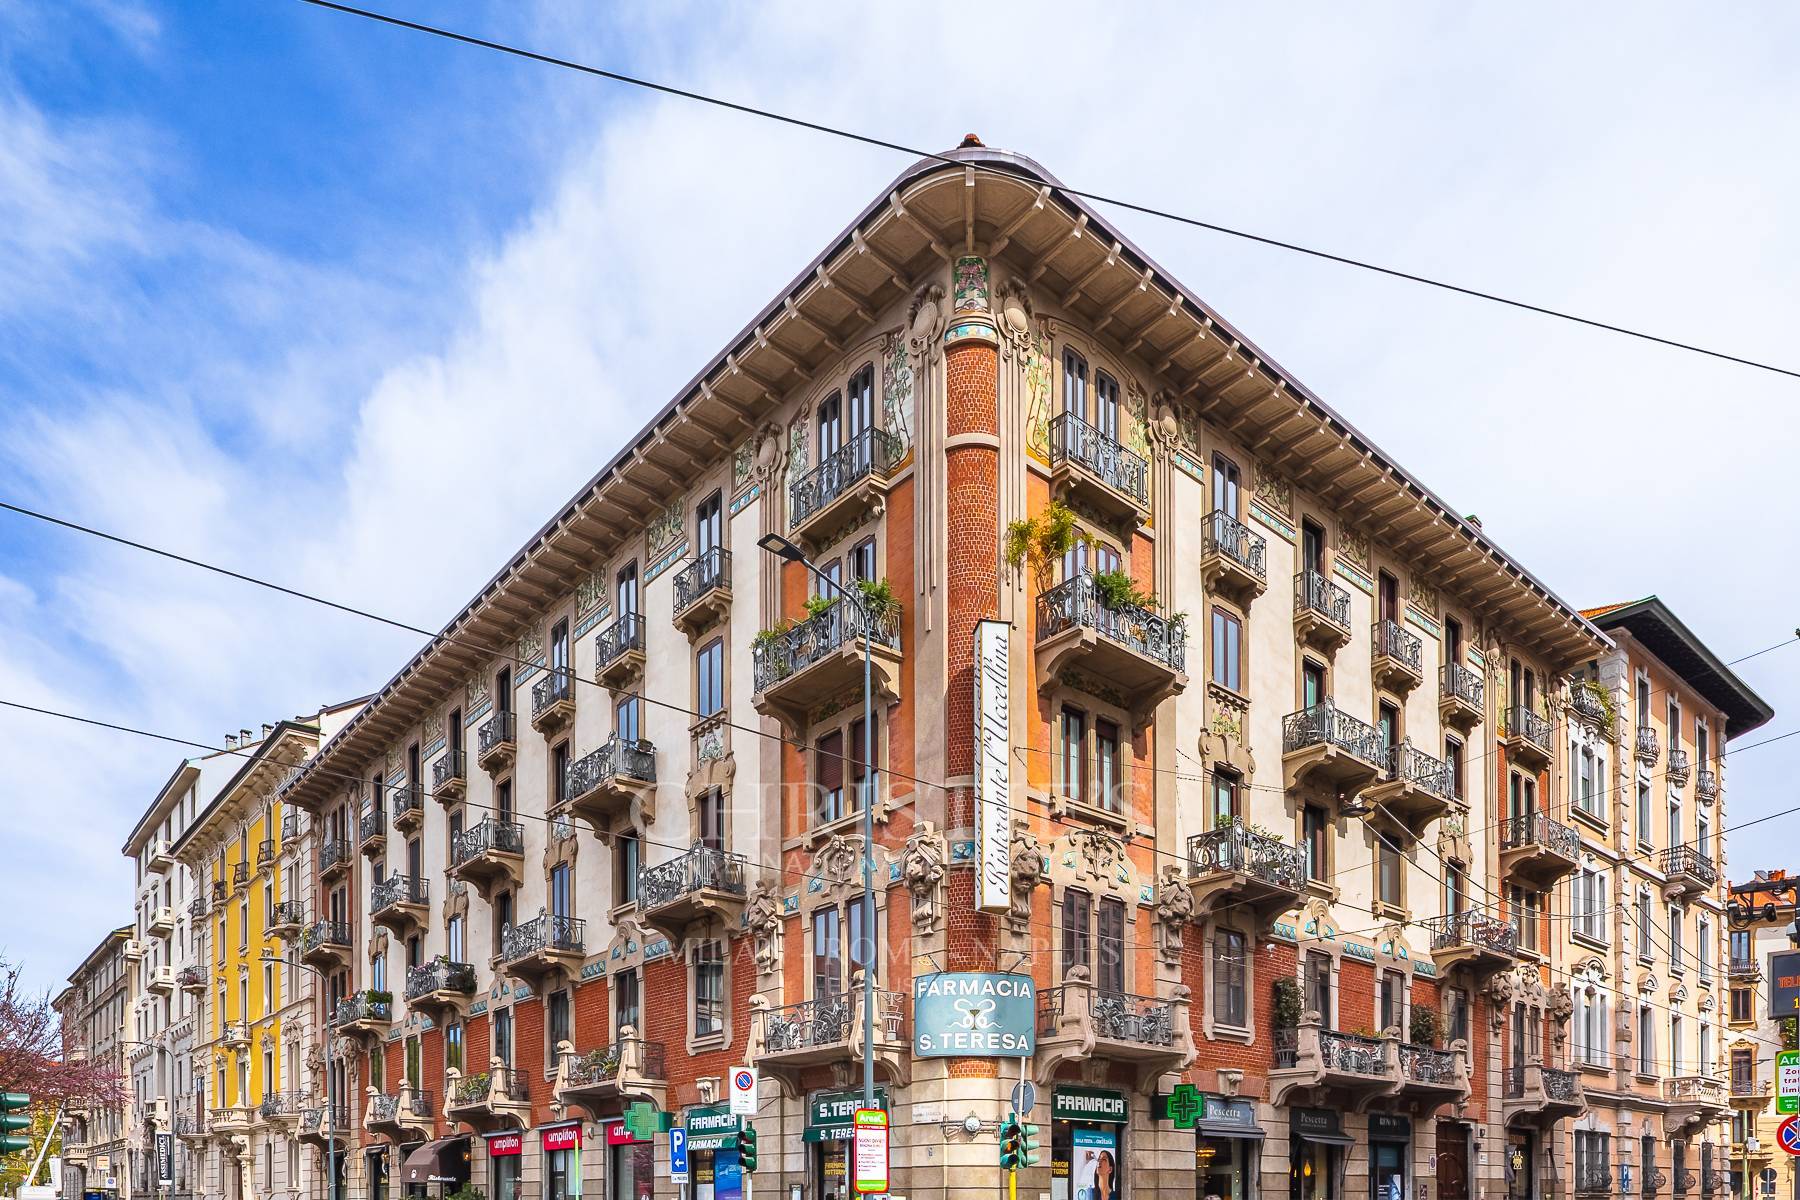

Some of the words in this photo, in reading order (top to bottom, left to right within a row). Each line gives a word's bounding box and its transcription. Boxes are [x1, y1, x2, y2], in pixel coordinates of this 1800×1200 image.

[984, 769, 1009, 895] Ristorante
[918, 979, 1031, 998] FARMACIA
[920, 1033, 936, 1050] S.
[940, 1032, 1029, 1050] TERESA
[1057, 1094, 1124, 1113] FARMACIA
[690, 1113, 737, 1130] FARMACIA
[493, 1138, 518, 1151] amplifon
[548, 1129, 577, 1145] amplifon
[673, 1131, 684, 1153] P
[688, 1139, 723, 1150] FARMACIA
